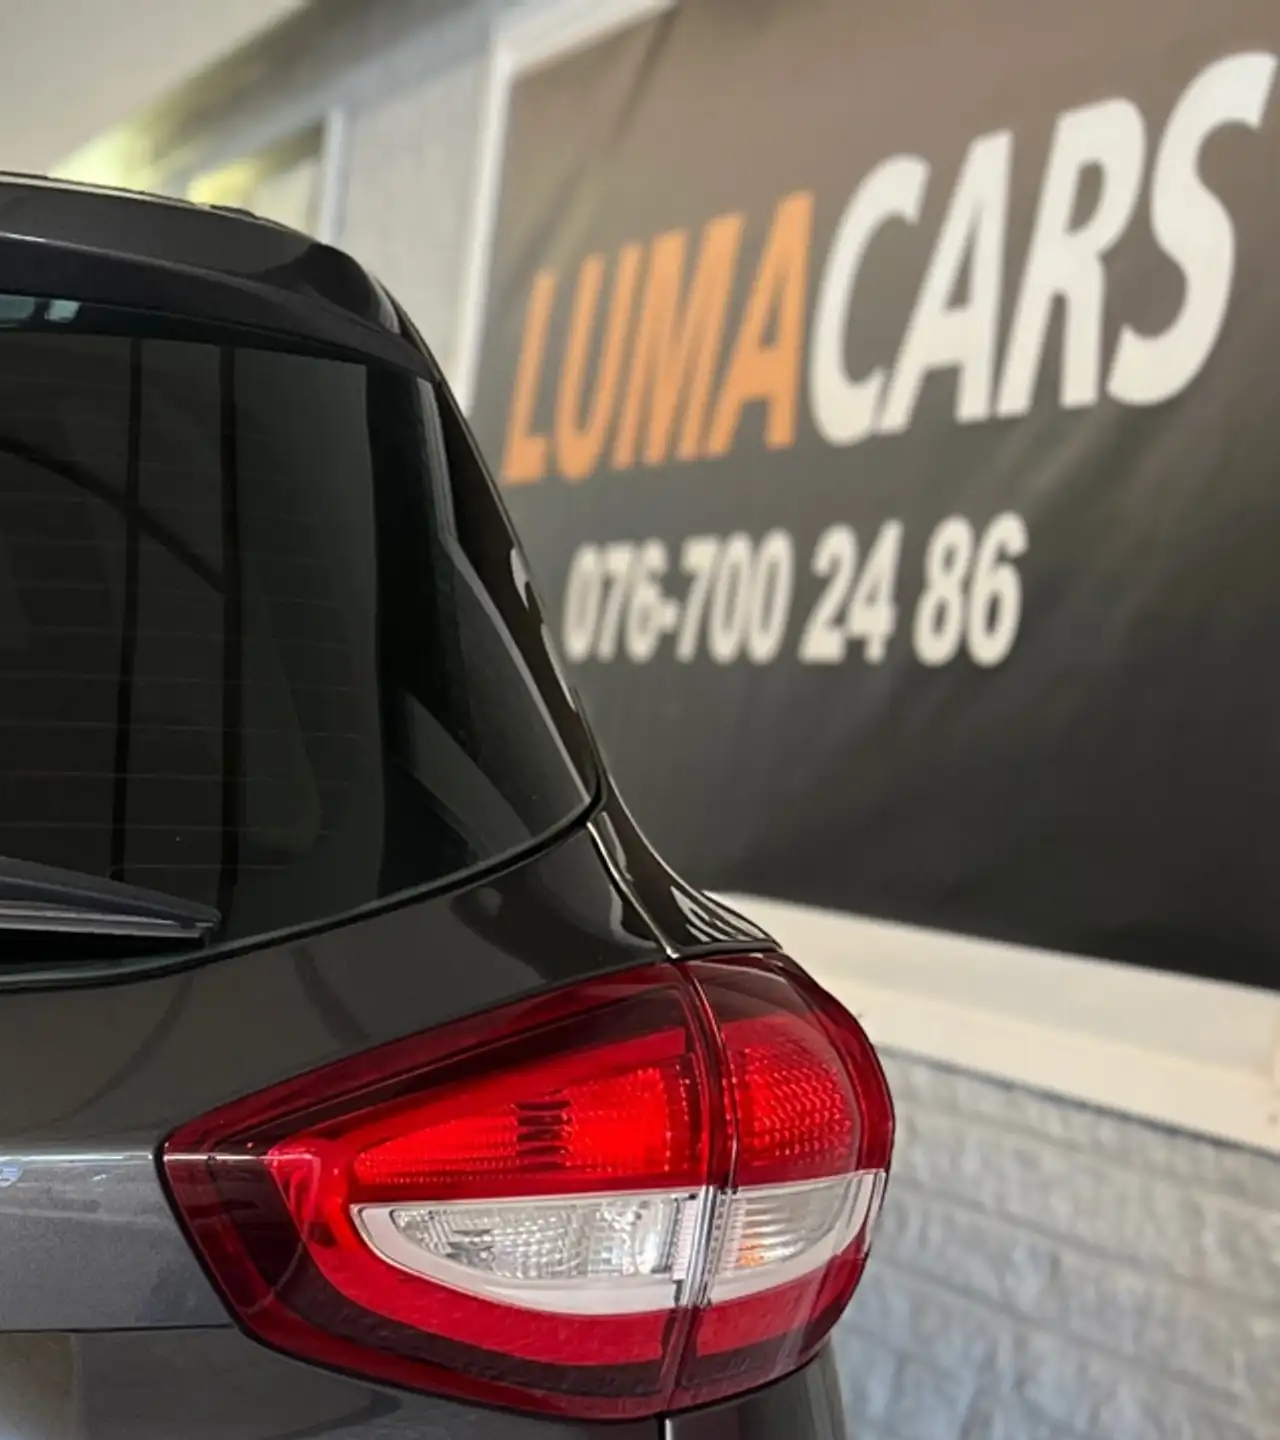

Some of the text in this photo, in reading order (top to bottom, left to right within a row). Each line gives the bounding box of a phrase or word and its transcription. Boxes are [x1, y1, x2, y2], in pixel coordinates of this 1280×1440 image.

[563, 511, 1028, 668] 076-700 24 86
